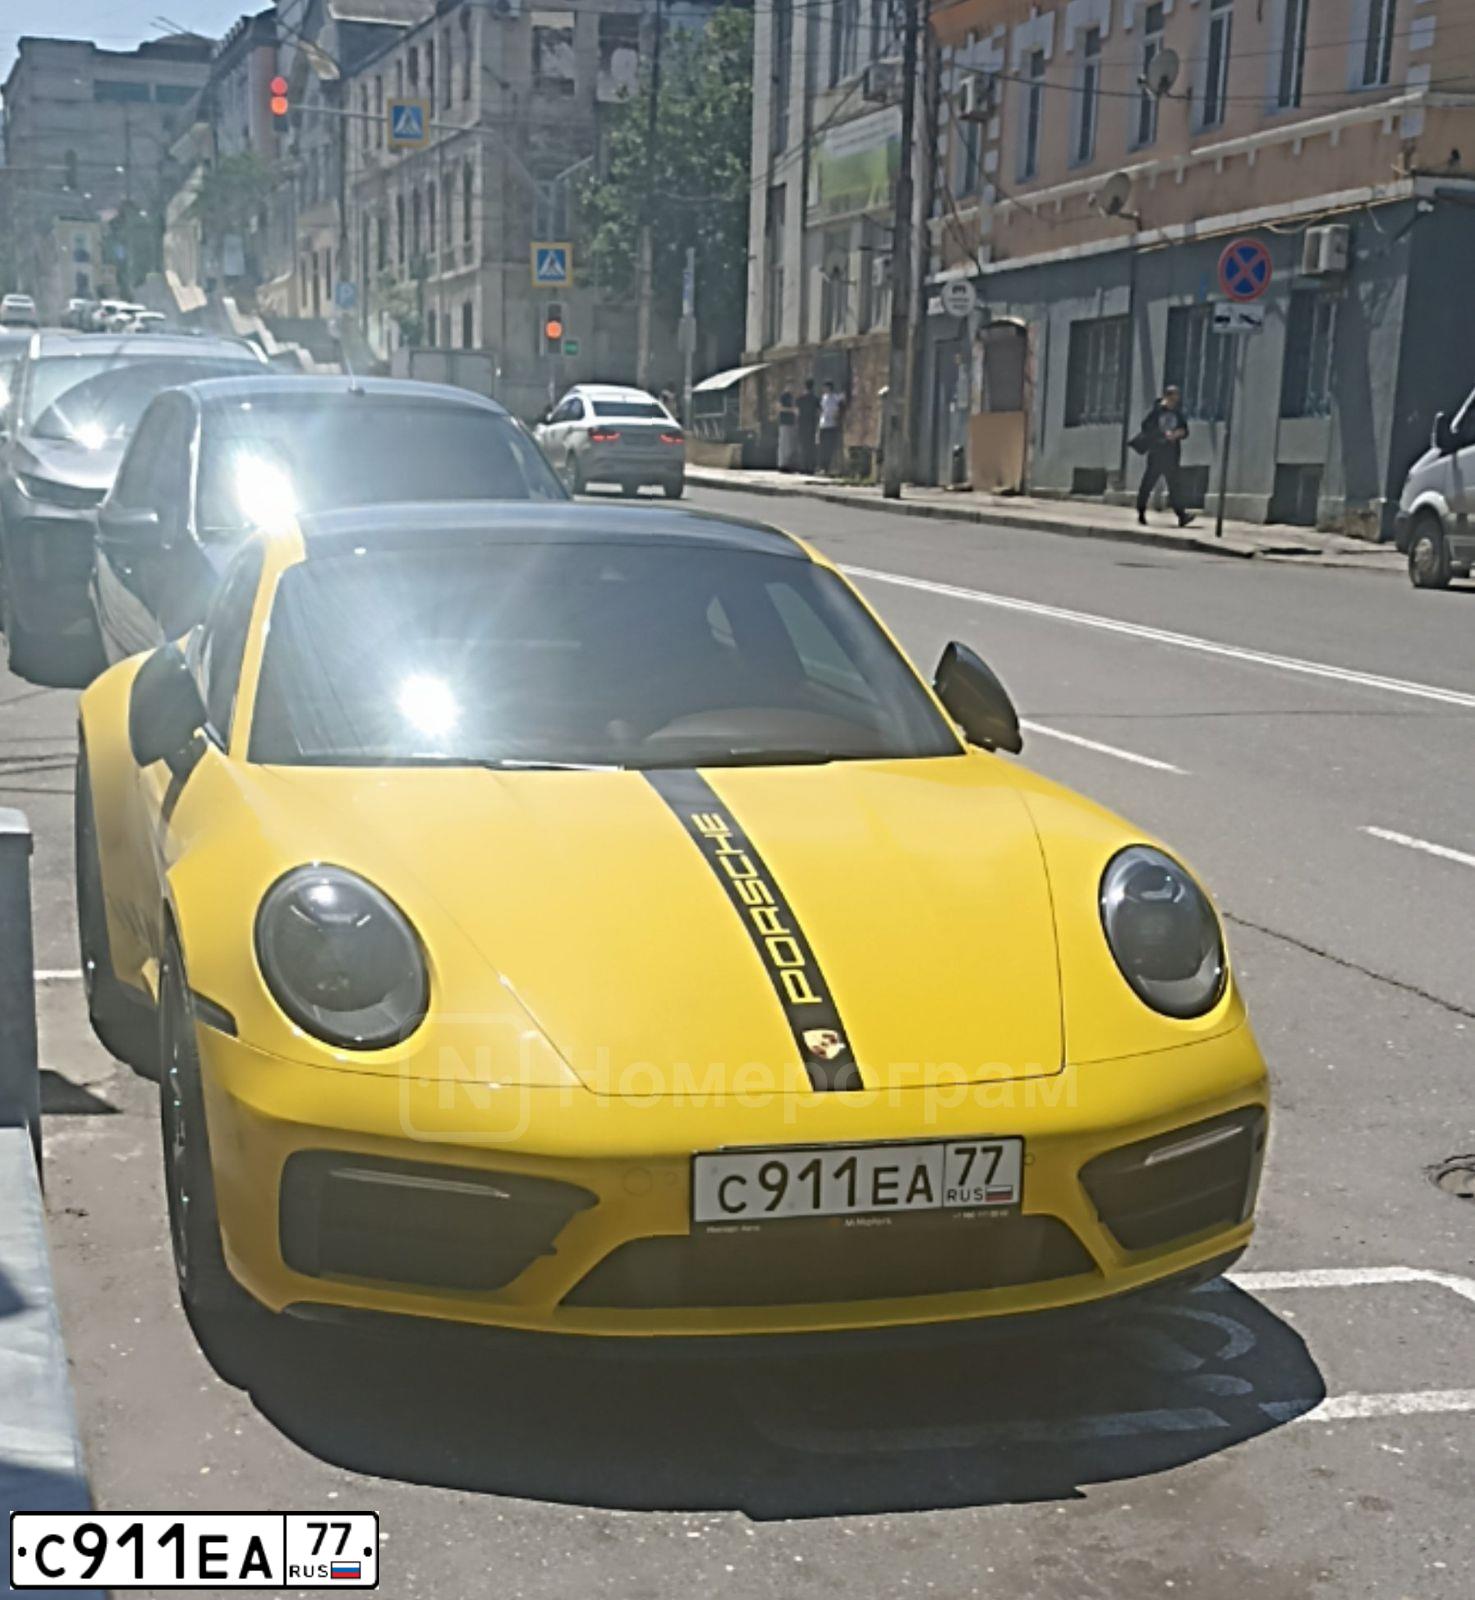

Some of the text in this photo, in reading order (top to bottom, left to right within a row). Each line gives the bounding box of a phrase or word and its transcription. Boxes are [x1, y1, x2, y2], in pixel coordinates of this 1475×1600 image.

[691, 813, 822, 1003] PORSCHE
[954, 1145, 1004, 1187] 77
[947, 1187, 984, 1201] RUS
